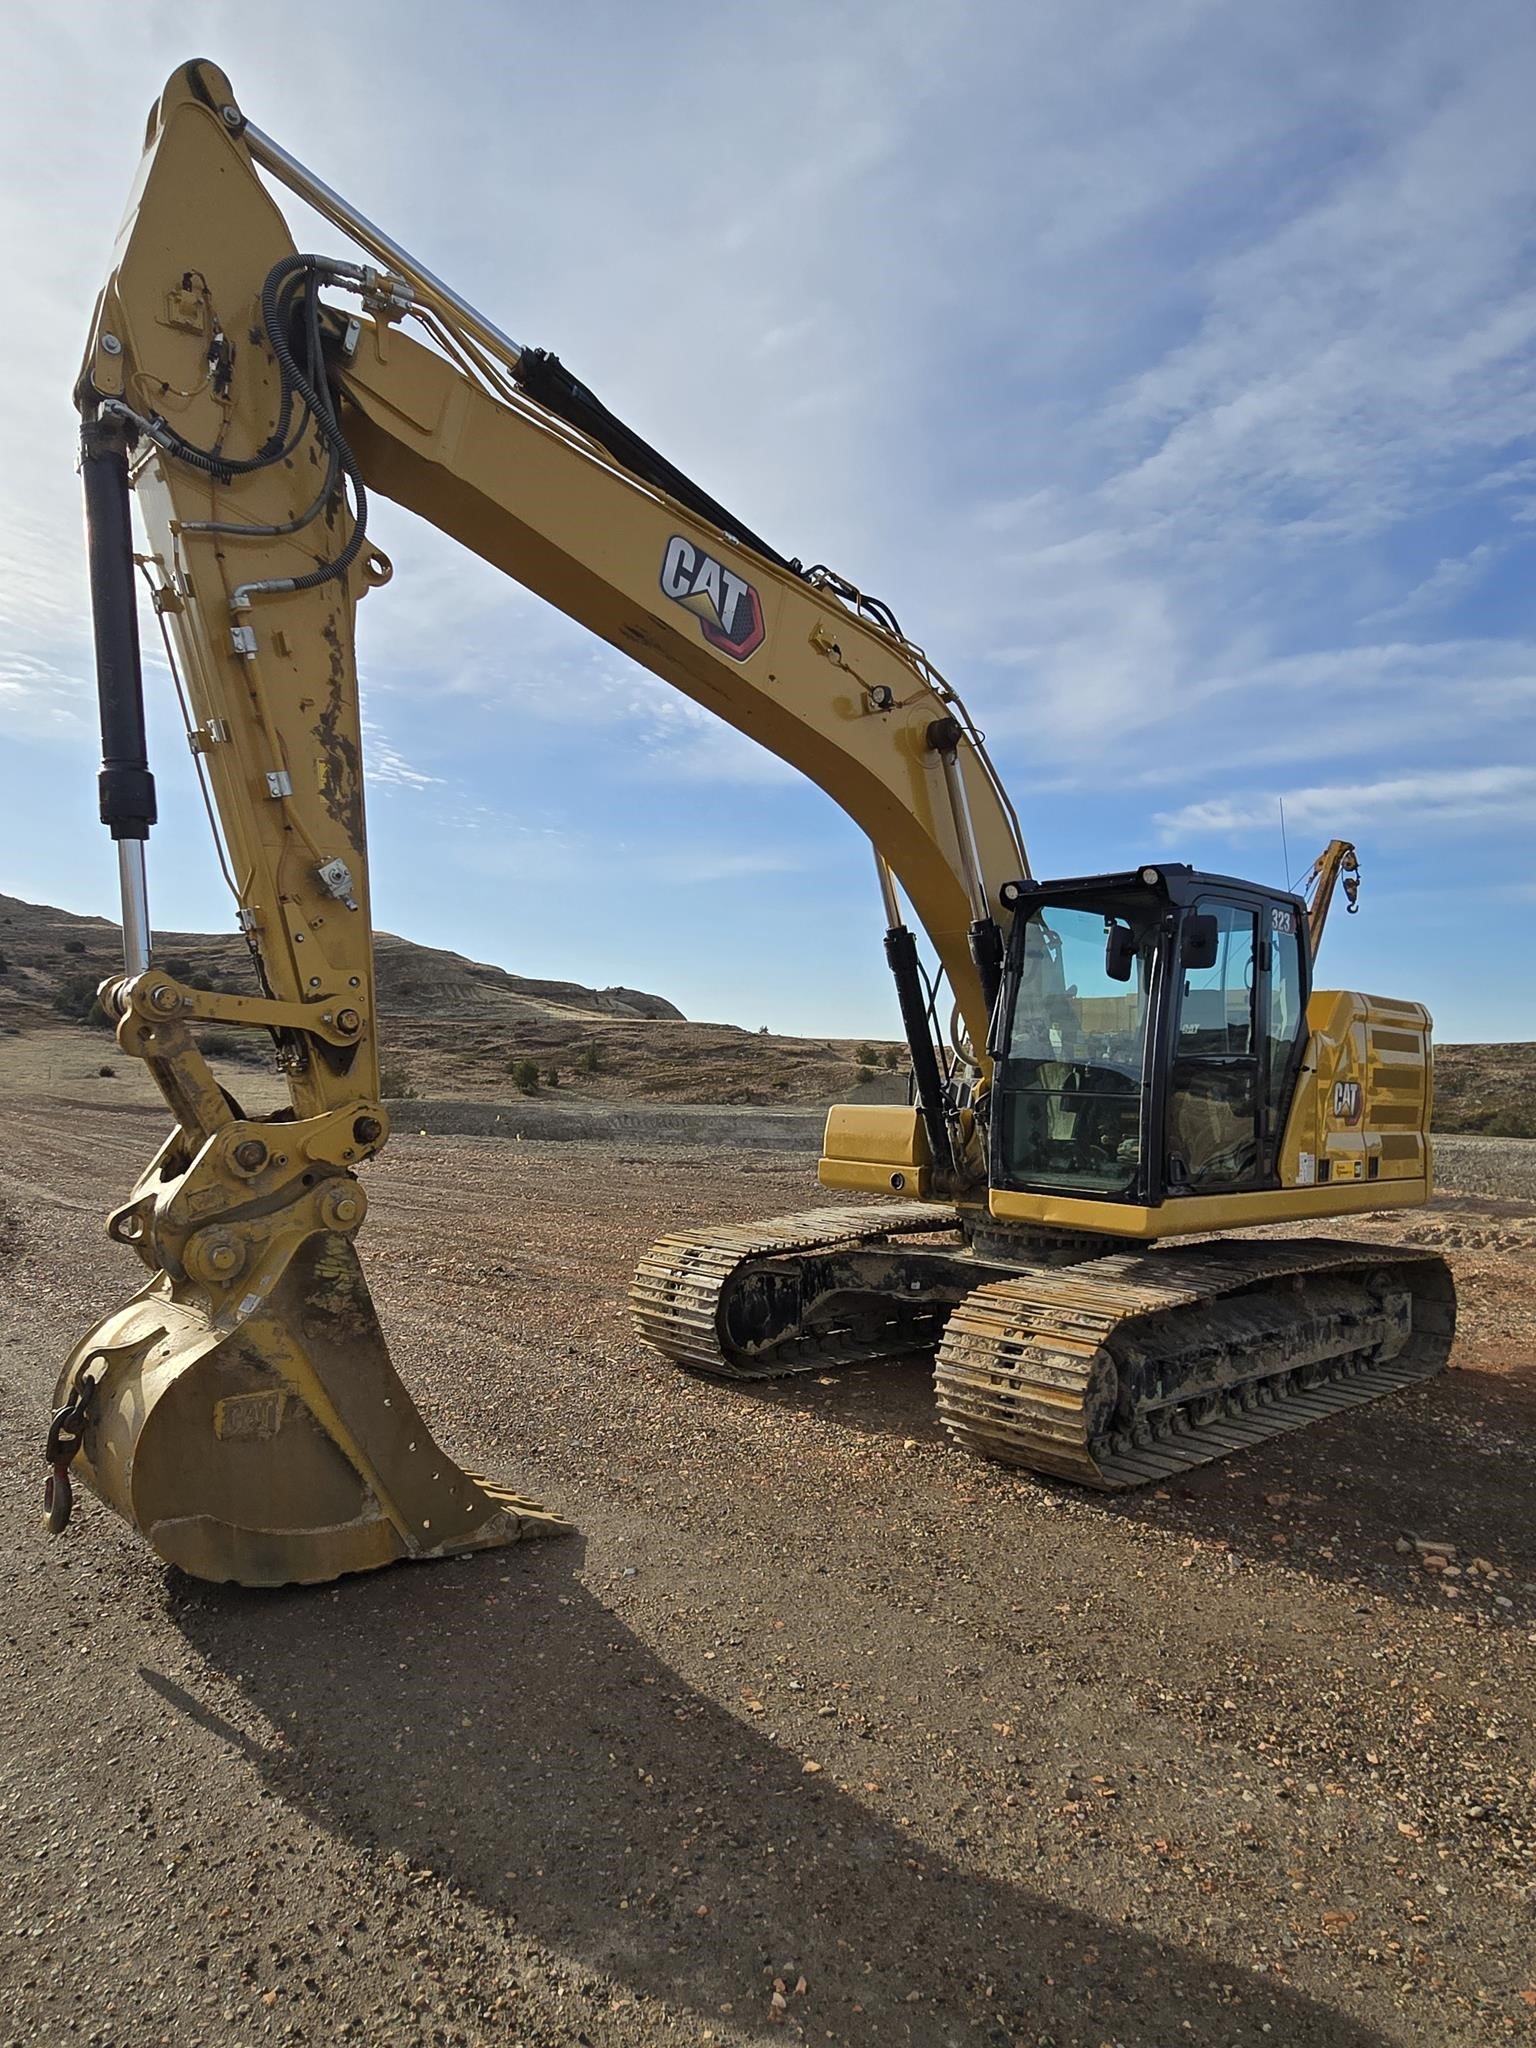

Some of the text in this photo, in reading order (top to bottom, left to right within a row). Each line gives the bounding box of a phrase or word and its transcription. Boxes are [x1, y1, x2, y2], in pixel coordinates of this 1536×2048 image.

[662, 536, 748, 634] CAT
[1272, 908, 1291, 932] 323
[1334, 1082, 1358, 1116] CAT
